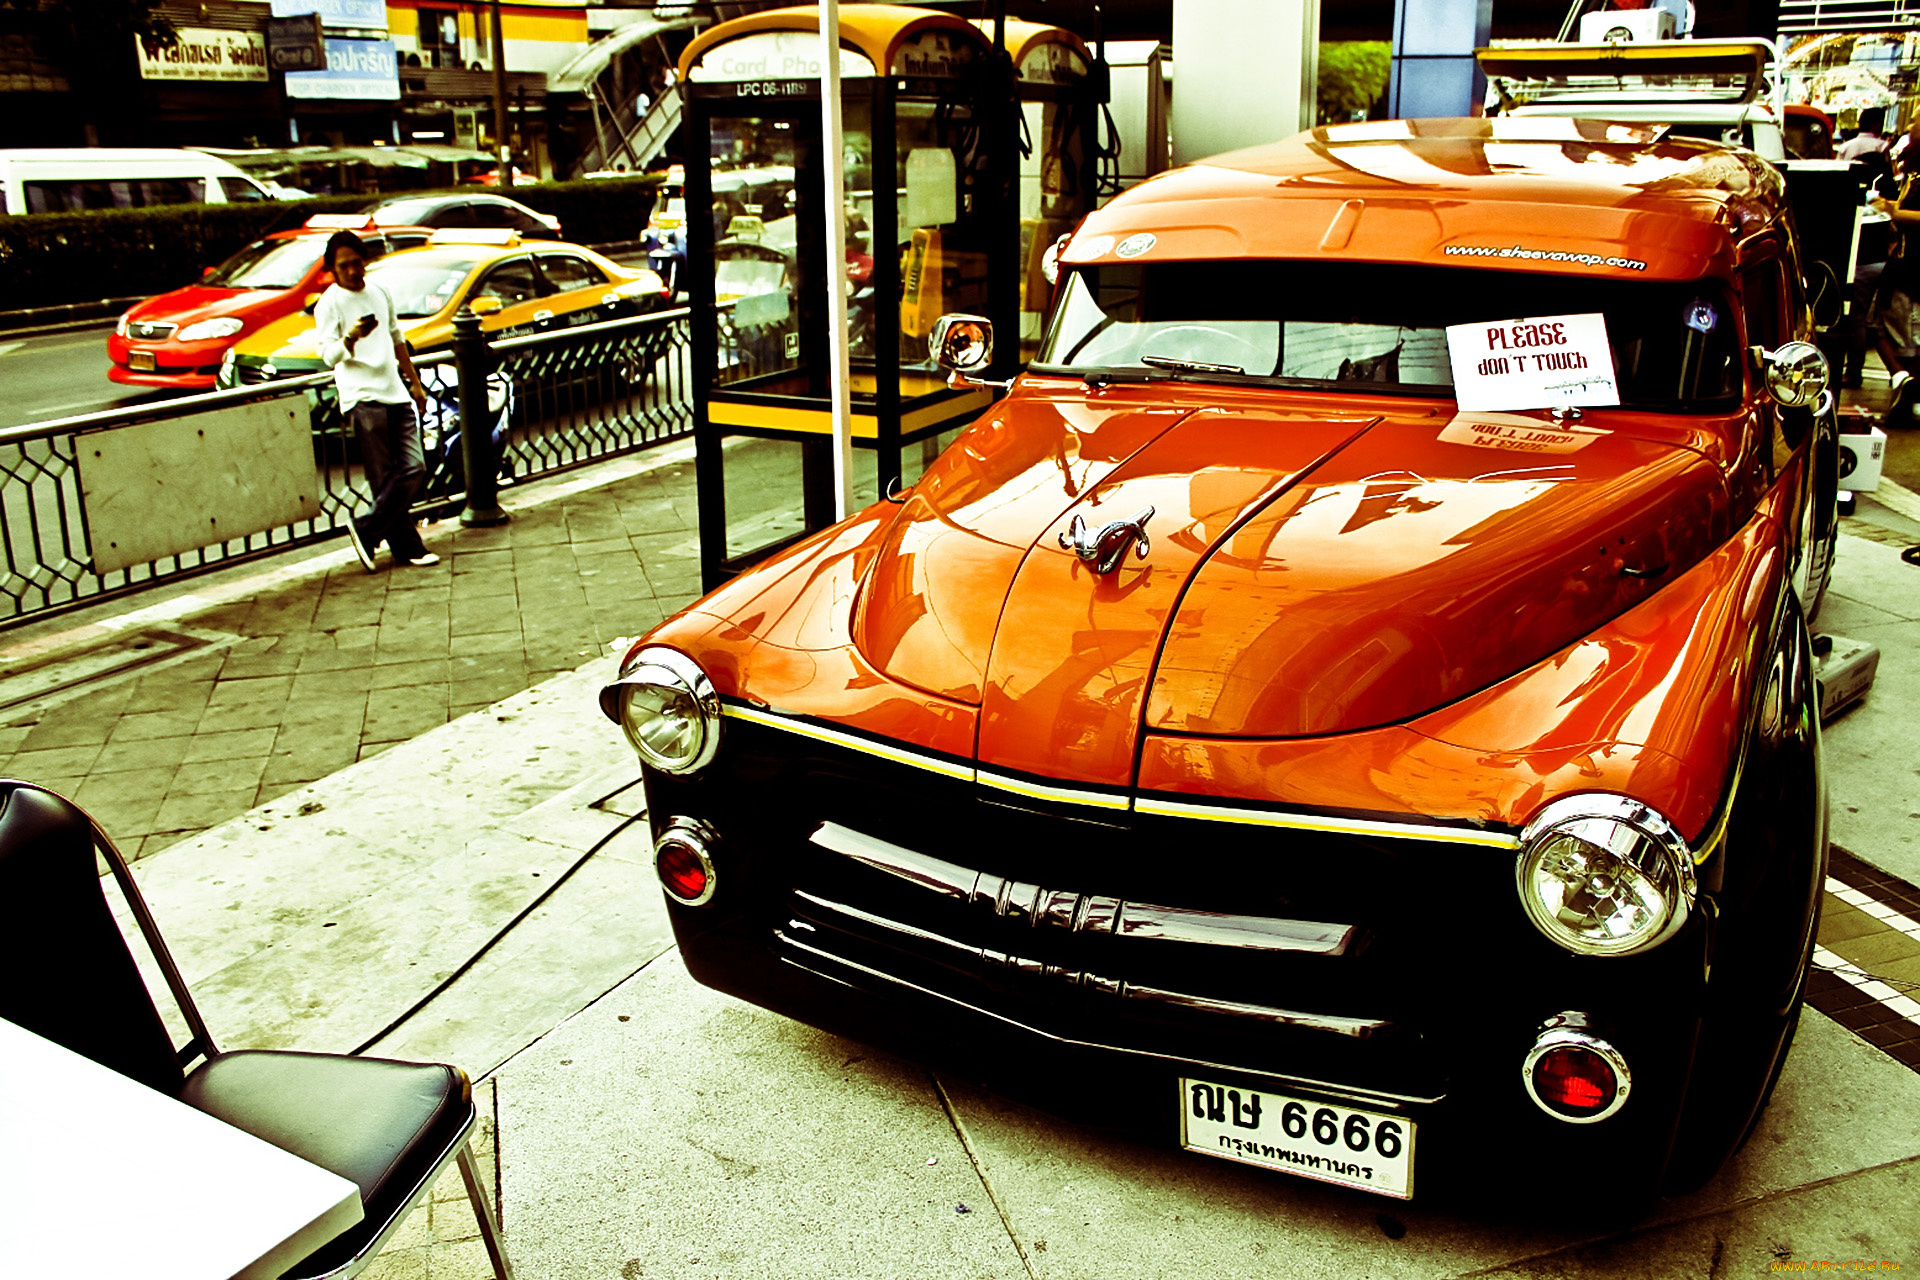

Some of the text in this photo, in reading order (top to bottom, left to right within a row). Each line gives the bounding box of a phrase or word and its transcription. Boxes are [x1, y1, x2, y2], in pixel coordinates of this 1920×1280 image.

[722, 57, 767, 75] Card
[737, 83, 760, 97] LPC
[1444, 244, 1648, 271] www.sheevawop.com
[1191, 1084, 1403, 1159] ณษ 6666
[1218, 1135, 1374, 1180] กรุงเทพมหานคร
